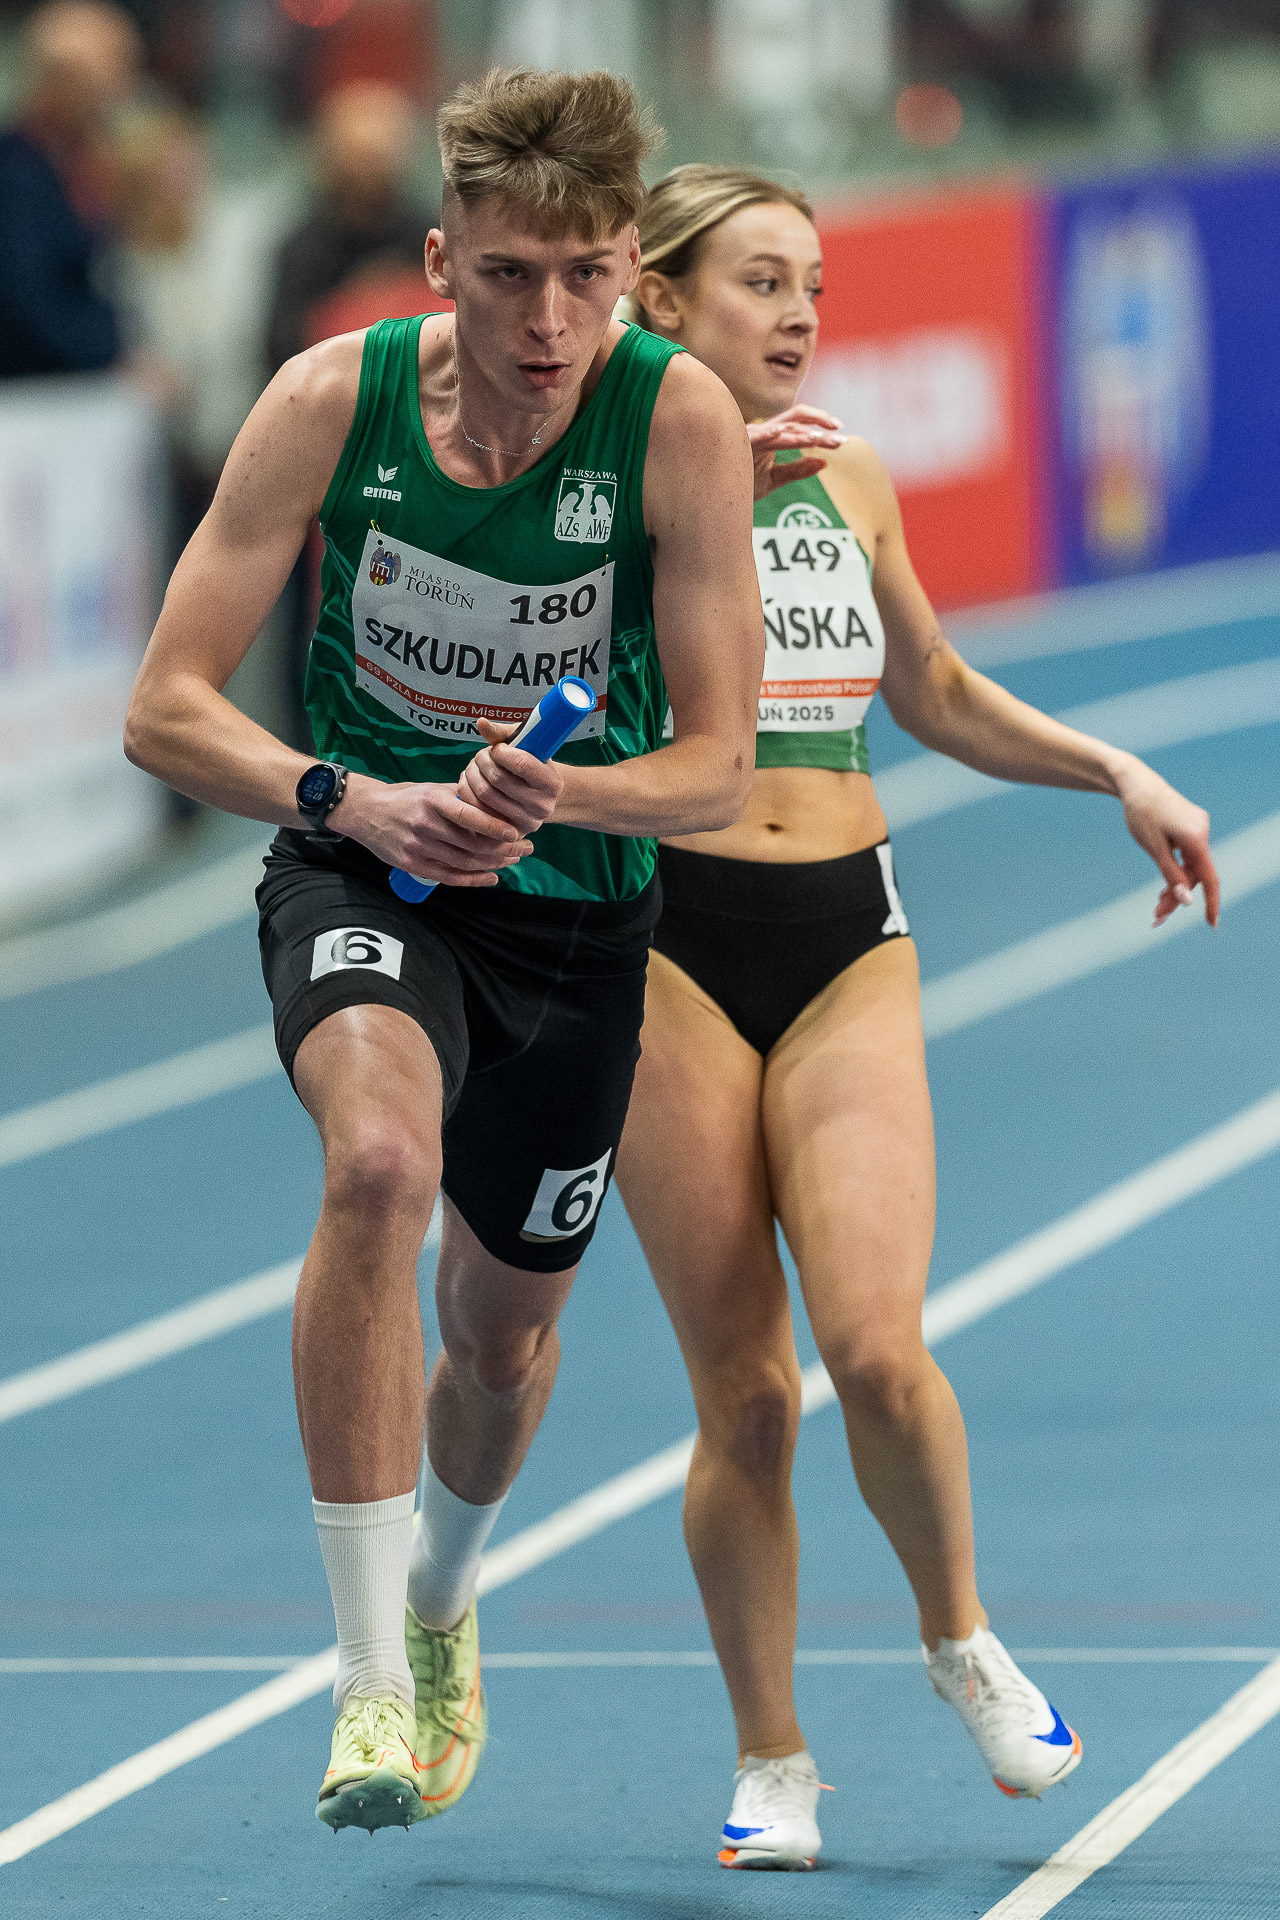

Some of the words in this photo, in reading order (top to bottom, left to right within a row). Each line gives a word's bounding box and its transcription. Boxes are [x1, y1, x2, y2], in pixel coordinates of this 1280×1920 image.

[563, 468, 618, 481] WARSZAWA
[363, 486, 402, 502] erma
[556, 516, 580, 538] AZS
[585, 518, 610, 540] AWF
[762, 538, 840, 572] 149
[404, 575, 475, 610] TORUŃ
[409, 566, 461, 592] MIASTO
[509, 583, 597, 625] 180
[764, 598, 873, 650] ŃSKA
[365, 617, 602, 687] SZKUDLAREK
[366, 662, 383, 679] 69.
[386, 675, 411, 699] PZLA
[415, 694, 467, 713] Halowe
[471, 705, 530, 719] Mistrzos
[758, 702, 783, 720] UŃ
[788, 705, 834, 721] 2025
[331, 931, 382, 965] 6
[551, 1169, 598, 1231] 6
